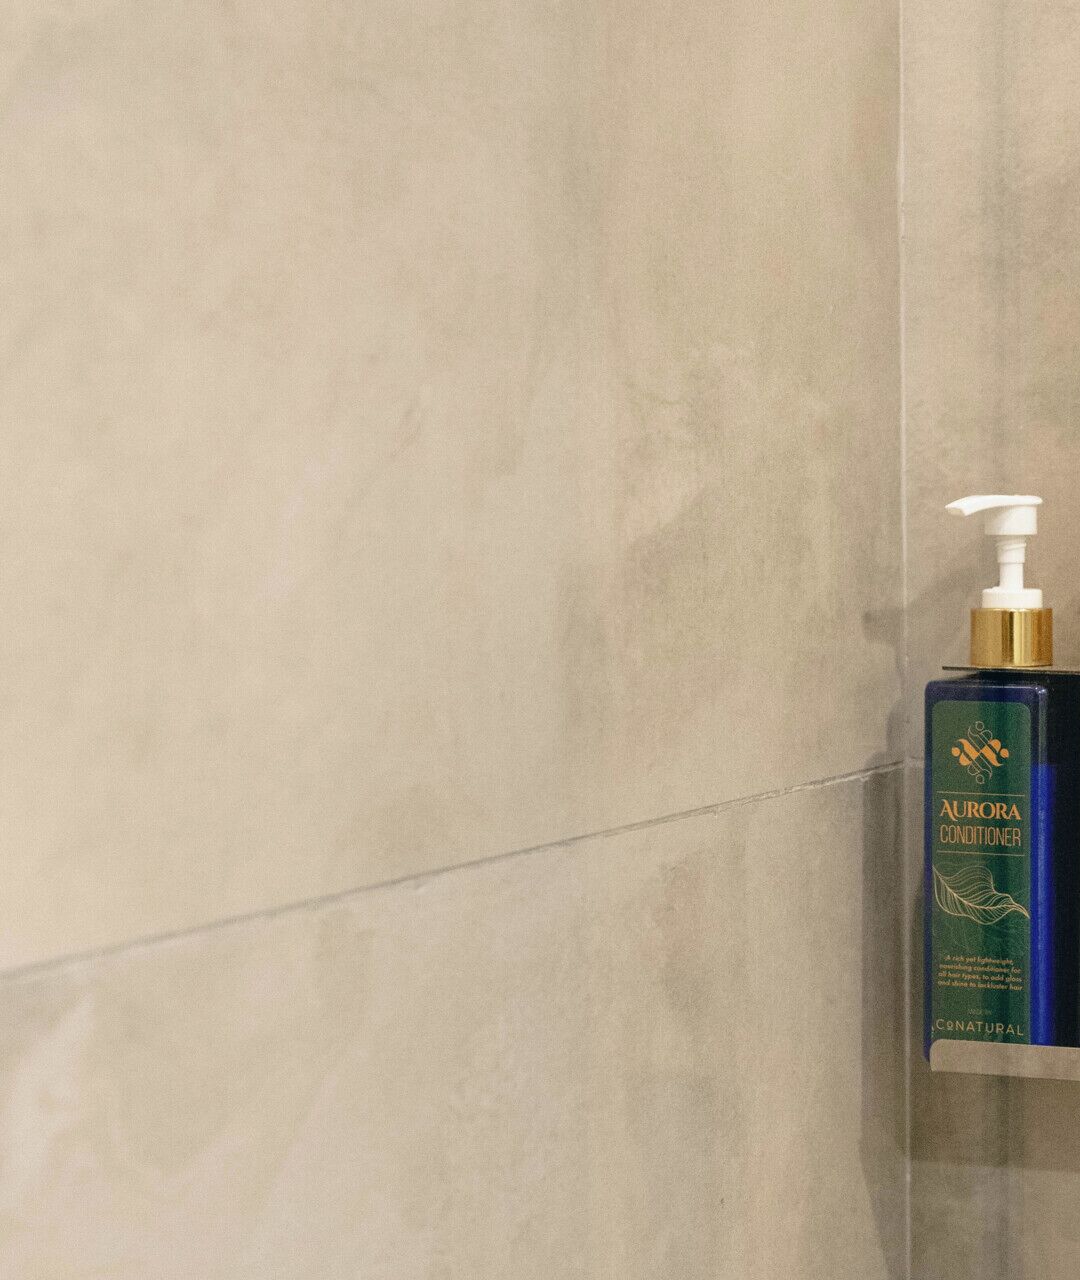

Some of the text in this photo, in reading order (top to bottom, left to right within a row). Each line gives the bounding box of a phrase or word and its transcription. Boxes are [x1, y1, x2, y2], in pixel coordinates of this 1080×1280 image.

[940, 799, 1022, 822] AURORA
[940, 824, 1021, 847] CONDITIONER
[1011, 966, 1021, 974] for
[1009, 983, 1023, 991] hair
